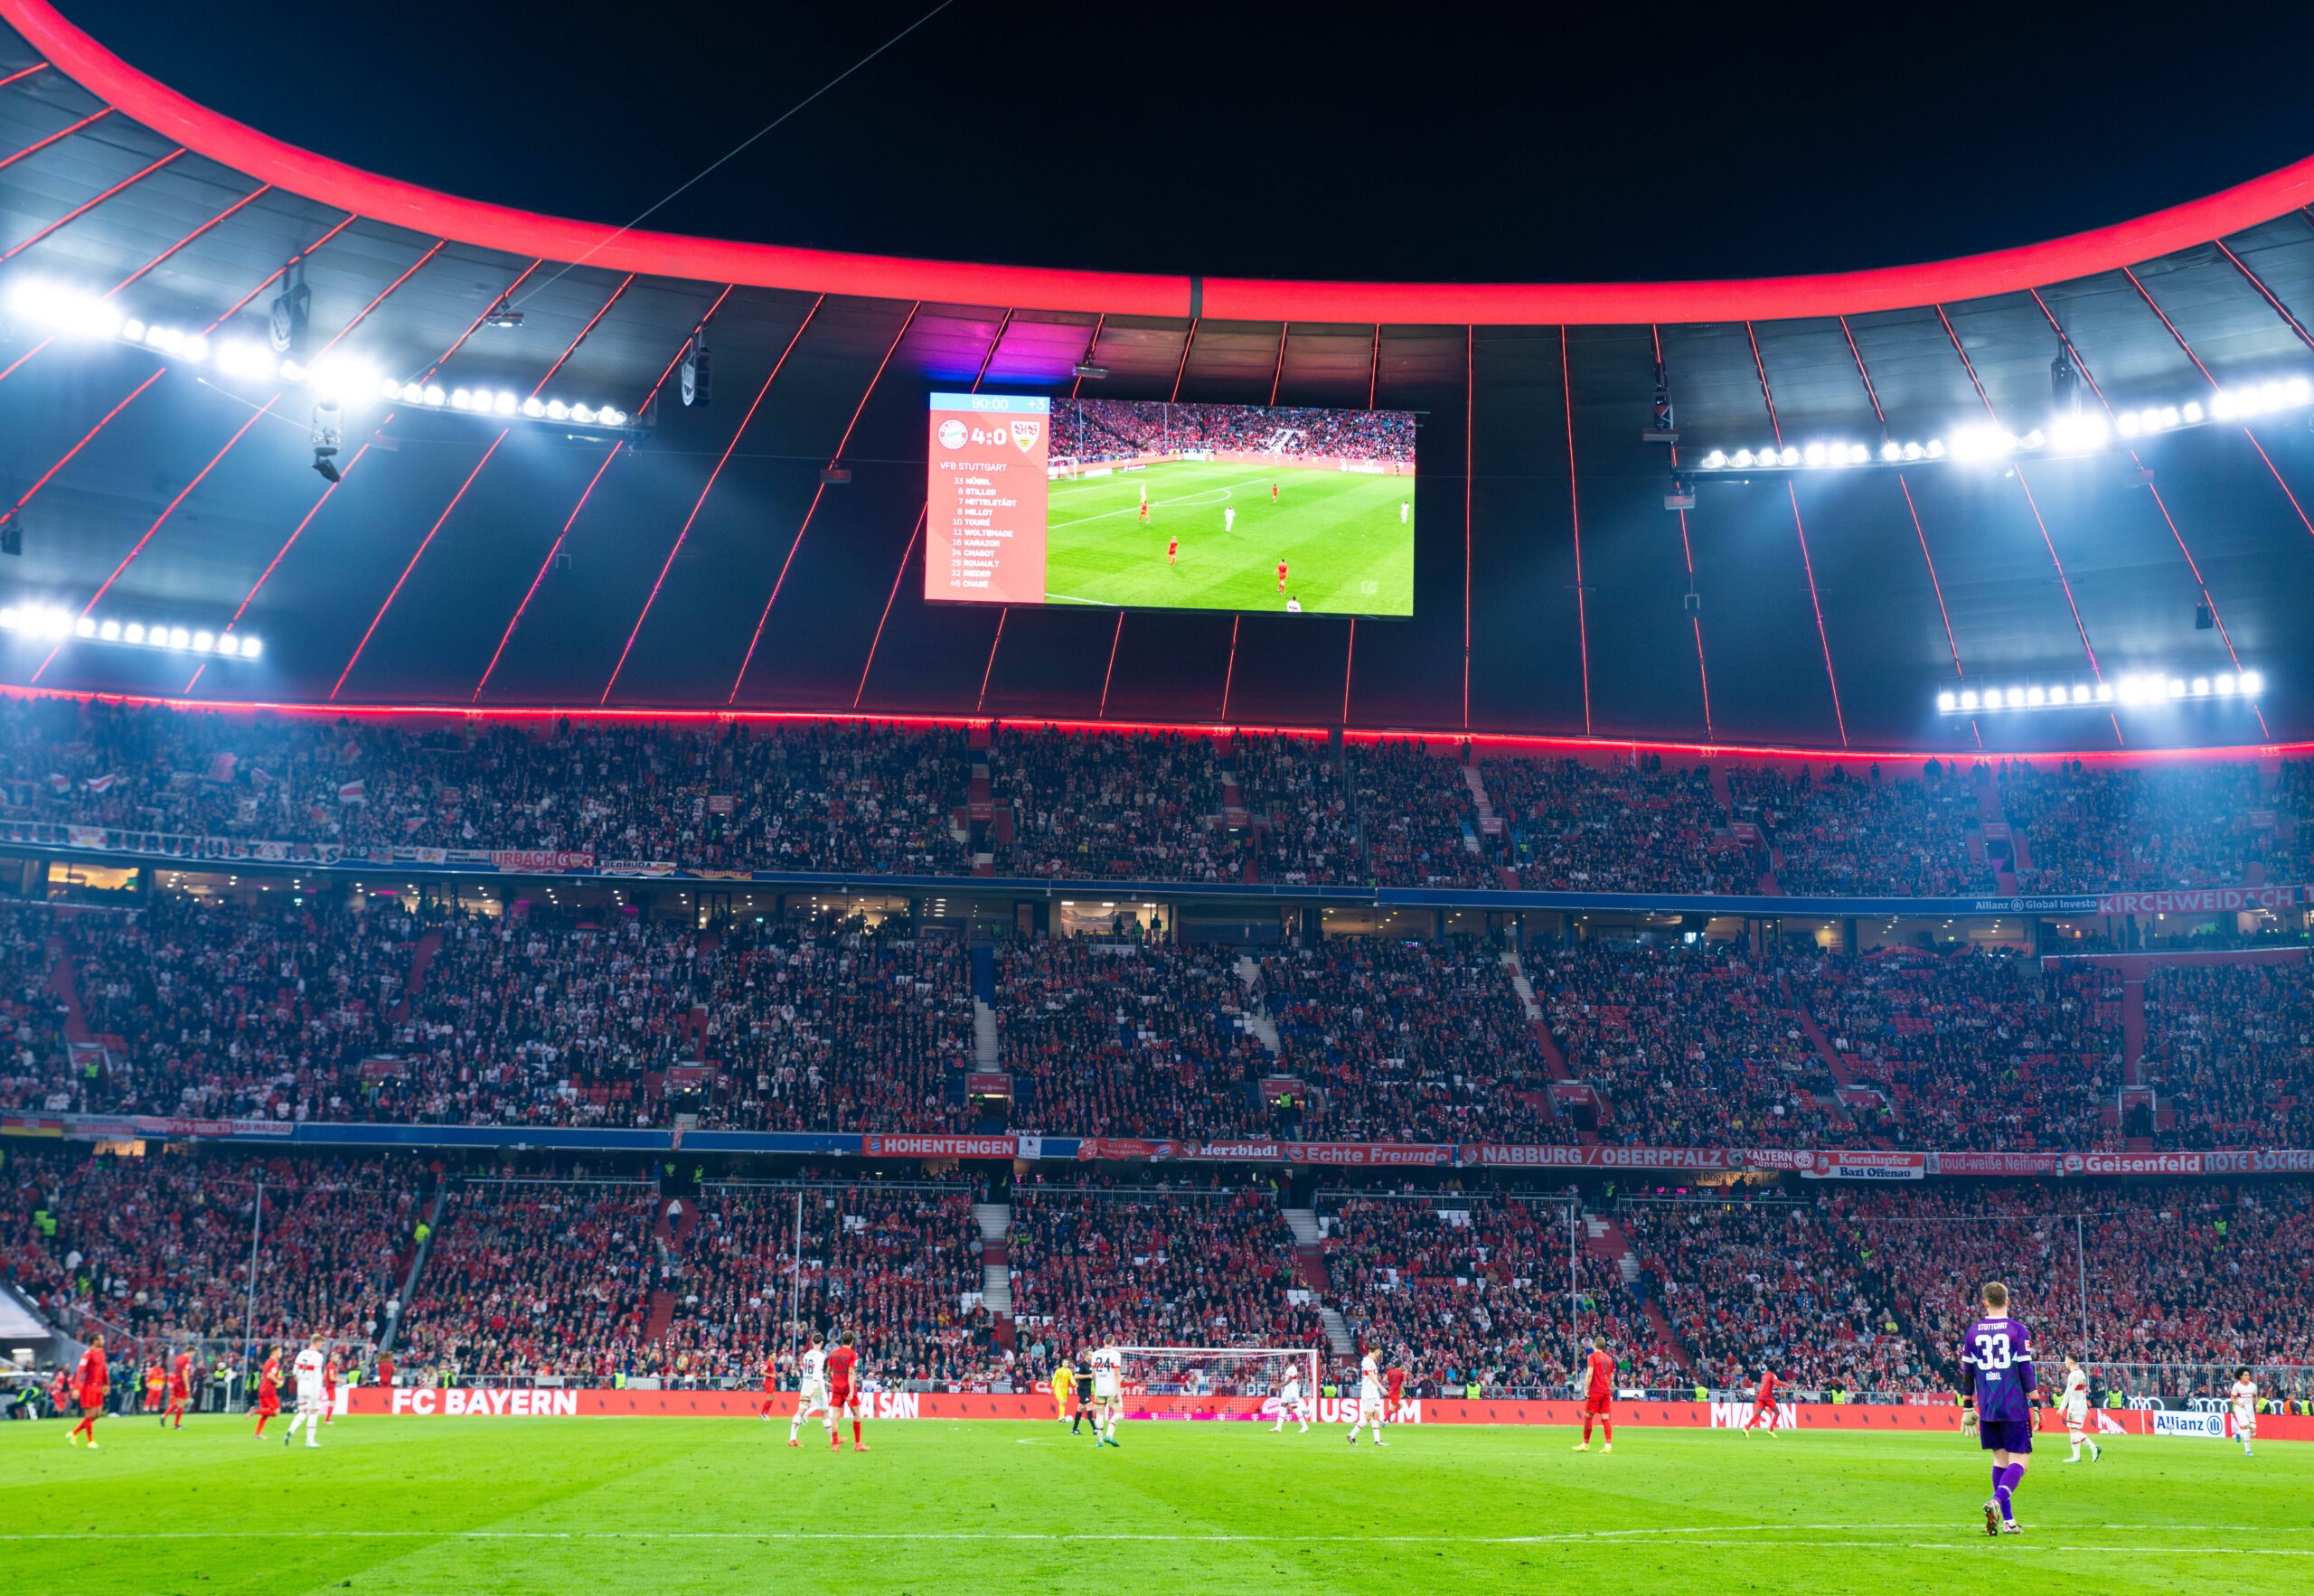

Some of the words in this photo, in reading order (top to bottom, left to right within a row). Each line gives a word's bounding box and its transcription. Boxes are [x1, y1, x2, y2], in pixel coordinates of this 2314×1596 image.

[972, 398, 1009, 410] 90:00
[1028, 399, 1045, 410] +3
[971, 427, 1007, 446] 4:0
[940, 462, 956, 470] VFB
[958, 463, 1008, 472] STUTTGART
[492, 852, 555, 866] URBACH
[604, 861, 652, 869] BERMUDA
[1975, 901, 2009, 910] Allianz
[2026, 899, 2057, 909] Global
[2100, 889, 2293, 913] KIRCHWEIDACH
[885, 1139, 1013, 1154] HOHENTENGEN
[1307, 1147, 1363, 1162] Echte
[1369, 1148, 1448, 1163] Freunde
[1482, 1147, 1582, 1164] NABBURG
[1586, 1148, 1598, 1164] /
[1601, 1148, 1722, 1166] OBERPFALZ
[1745, 1150, 1792, 1161] KALTERN
[1839, 1153, 1911, 1167] Kornlupfer
[2205, 1153, 2248, 1171] ROTE
[2086, 1156, 2200, 1171] Geisenfeld
[1703, 1172, 1721, 1184] Dog
[1839, 1167, 1864, 1178] Bazi
[1867, 1167, 1911, 1178] Offenau
[1977, 1322, 2008, 1330] STUTTGART
[1975, 1333, 2011, 1370] 33
[804, 1358, 814, 1375] 16
[832, 1357, 848, 1374] 25
[1096, 1357, 1111, 1373] 24
[1602, 1360, 1609, 1375] 9
[392, 1389, 436, 1415] FC
[445, 1389, 578, 1415] BAYERN
[879, 1393, 919, 1418] SAN
[1299, 1397, 1421, 1423] MUSUM
[1710, 1403, 1754, 1428] MIA
[2156, 1415, 2204, 1431] Allianz
